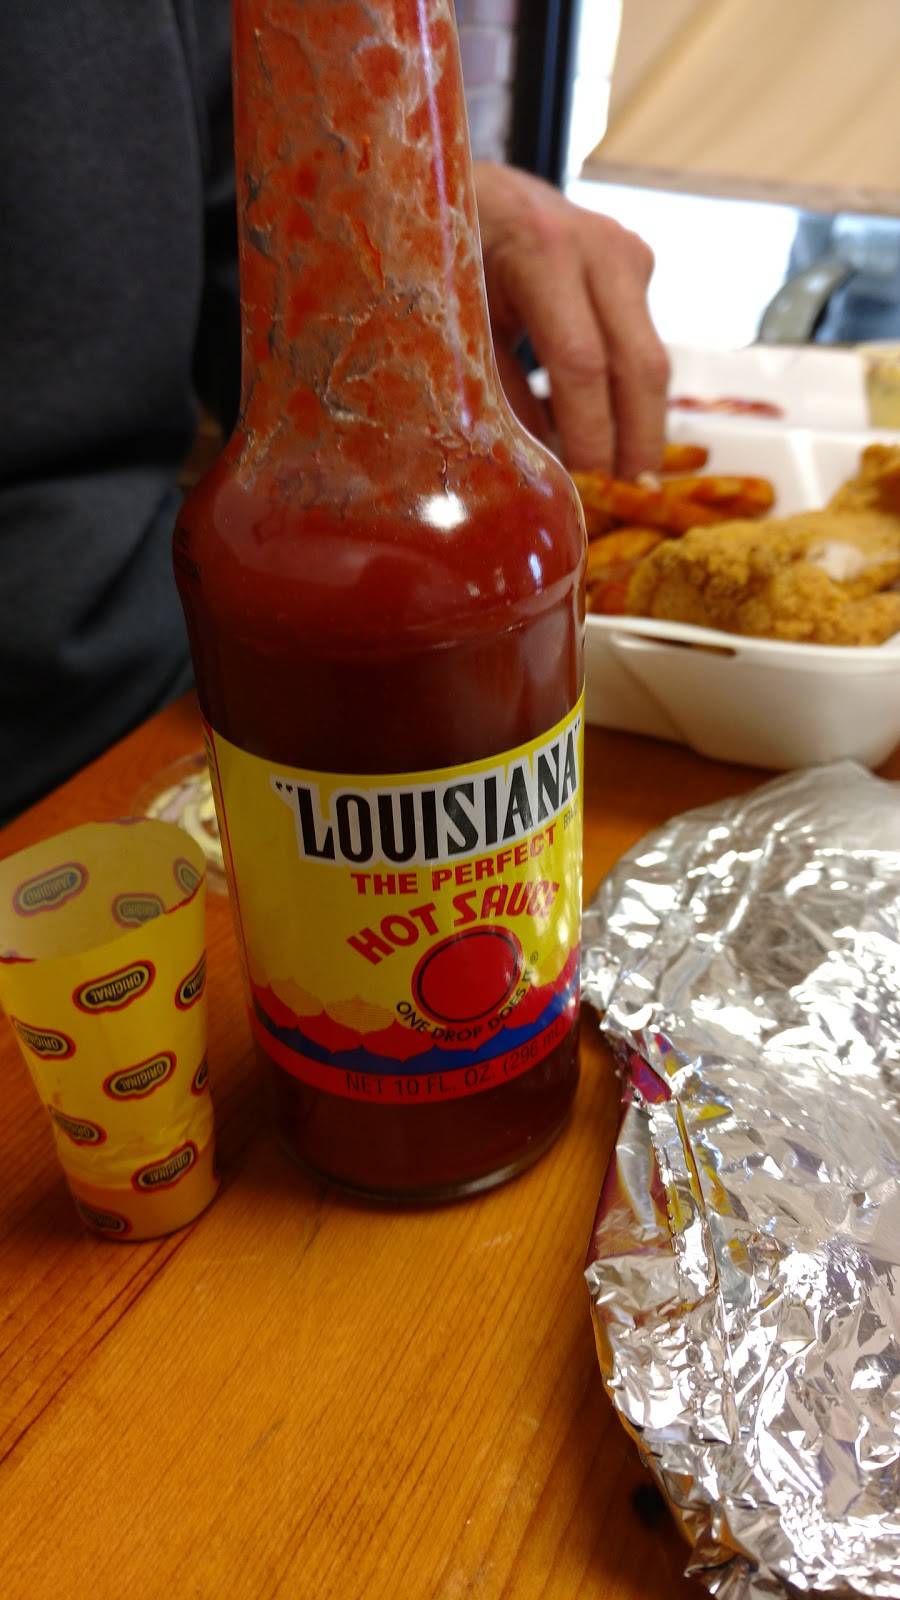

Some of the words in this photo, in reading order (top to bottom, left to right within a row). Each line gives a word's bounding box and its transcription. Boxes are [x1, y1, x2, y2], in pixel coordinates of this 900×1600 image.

[350, 872, 418, 896] THE
[431, 823, 557, 892] PERFECT
[346, 902, 439, 965] HOT
[452, 880, 560, 927] SAUCE
[91, 972, 142, 999] ORIGINAL
[396, 1001, 430, 1033] ONE
[431, 1024, 483, 1043] DROP
[487, 987, 527, 1031] DOES
[121, 1062, 164, 1087] ORIGINAL
[344, 1071, 383, 1095] NET
[394, 1079, 420, 1097] 10
[503, 1045, 539, 1075] (296
